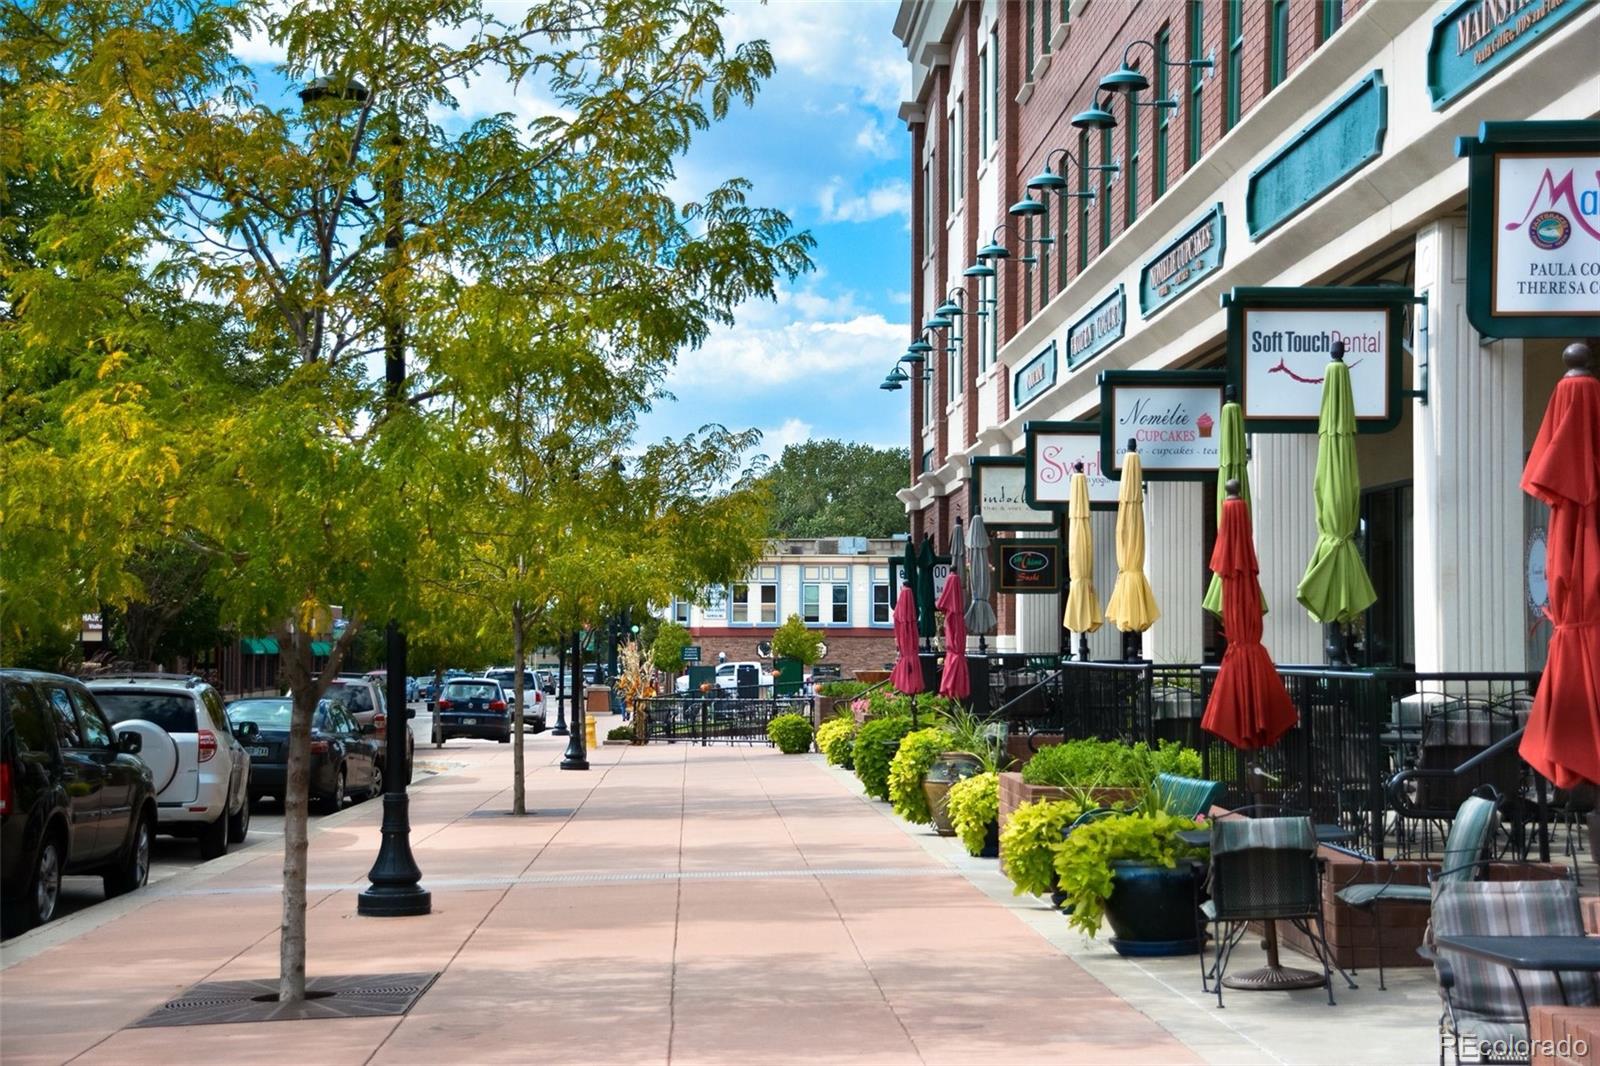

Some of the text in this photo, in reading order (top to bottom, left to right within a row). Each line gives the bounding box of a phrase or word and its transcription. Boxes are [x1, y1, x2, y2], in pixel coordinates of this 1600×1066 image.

[1530, 263, 1577, 276] PAULA
[1517, 281, 1600, 295] THERESA C
[1252, 331, 1283, 353] Soft
[1120, 397, 1192, 425] Nomélie
[1135, 429, 1196, 442] CUPCAKES
[1151, 446, 1194, 456] cupcakes
[1202, 447, 1218, 455] tea
